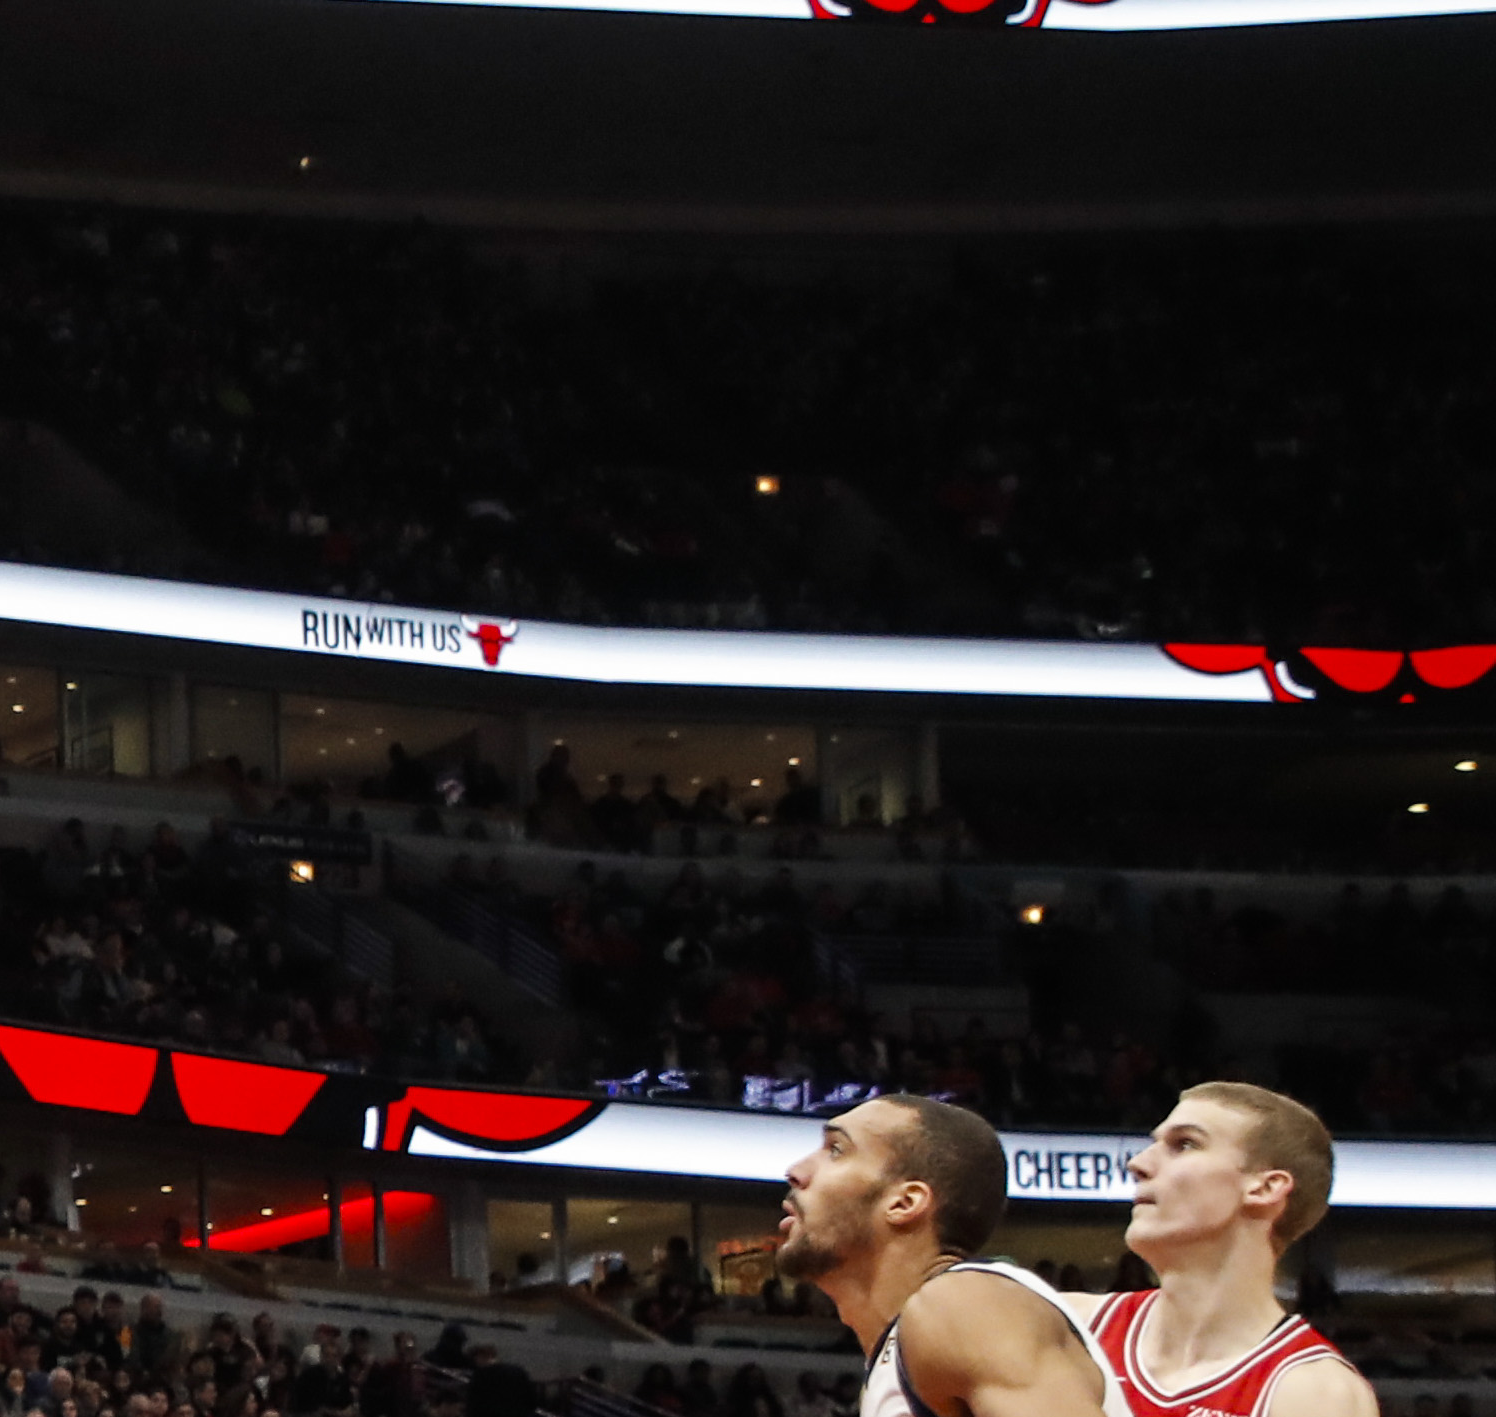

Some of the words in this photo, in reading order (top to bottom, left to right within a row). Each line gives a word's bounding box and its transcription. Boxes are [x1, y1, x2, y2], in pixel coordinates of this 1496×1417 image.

[301, 609, 361, 650] RUN
[366, 613, 424, 649] WITH
[431, 621, 462, 653] US
[1015, 1150, 1113, 1191] CHEER
